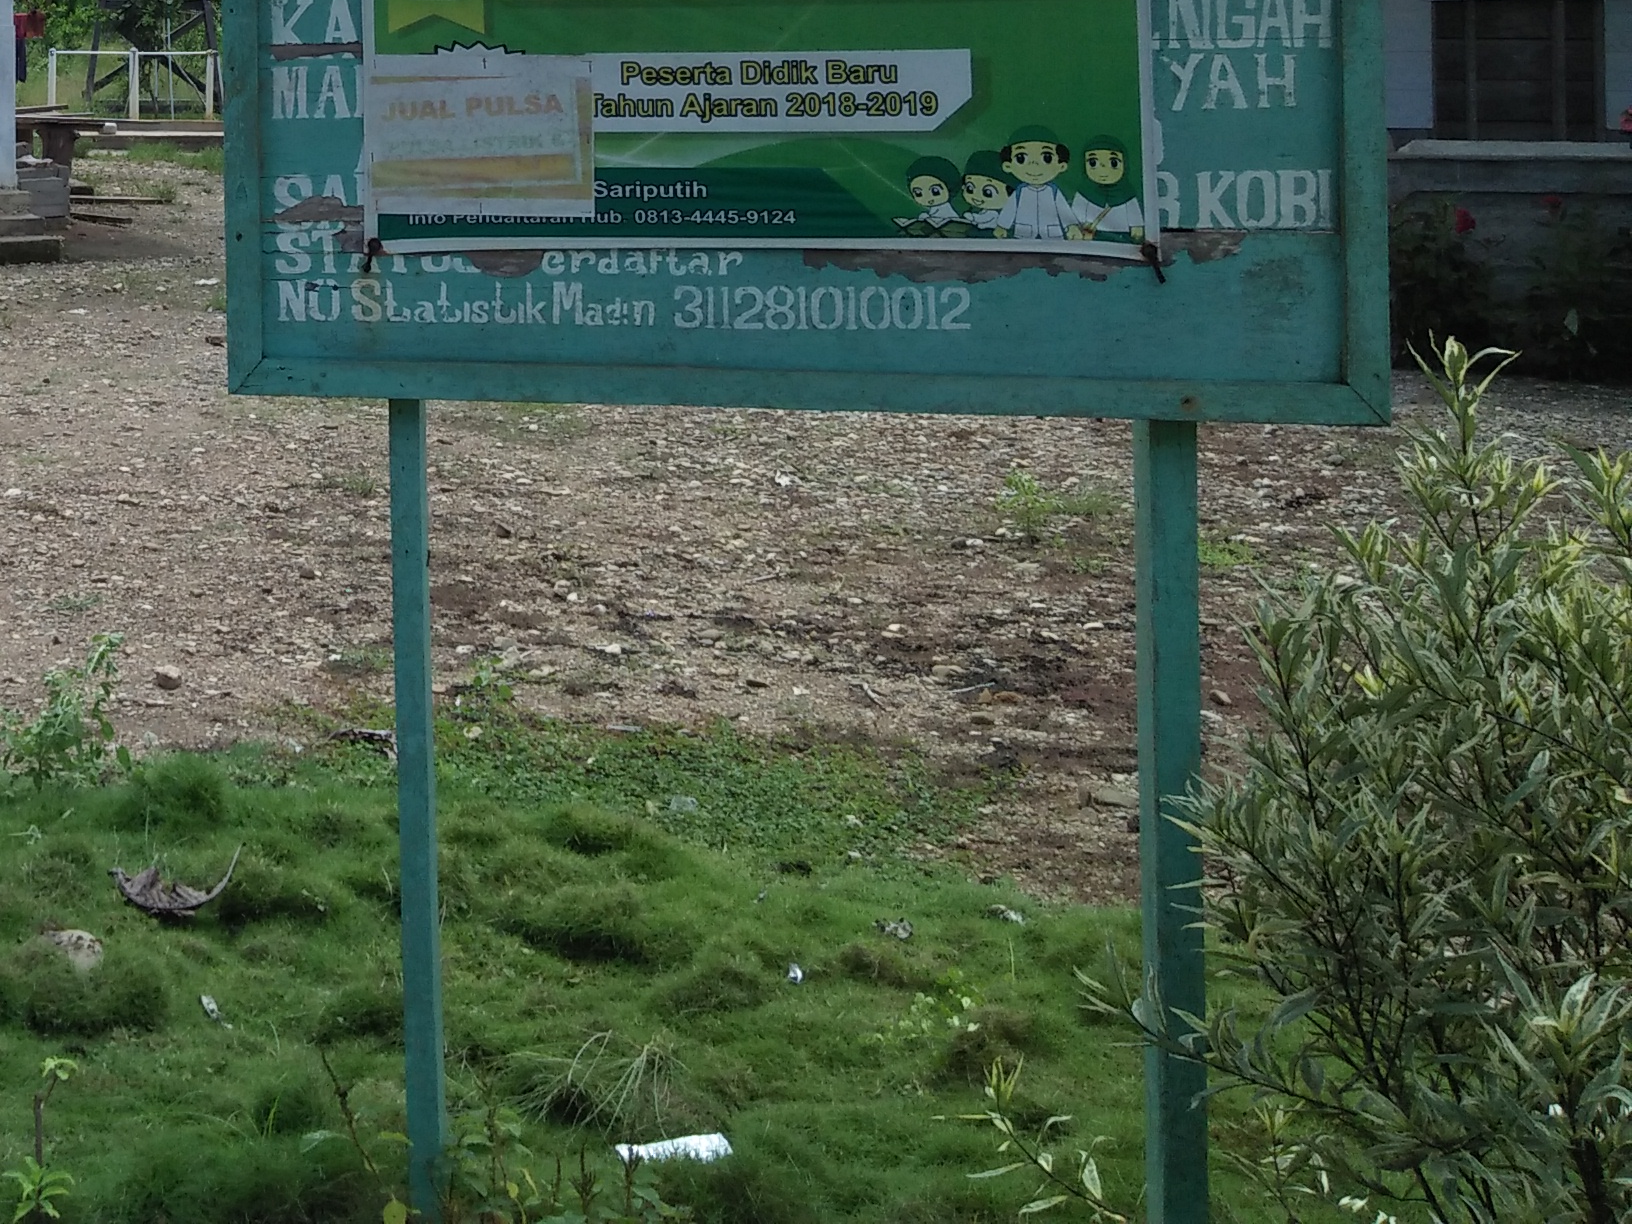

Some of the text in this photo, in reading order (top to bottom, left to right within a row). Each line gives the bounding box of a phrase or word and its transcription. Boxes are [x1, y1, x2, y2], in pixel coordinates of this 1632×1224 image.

[620, 59, 898, 86] Peserta Didik Baru
[381, 93, 565, 122] JUAL PULSA
[679, 93, 779, 123] Ajaran
[784, 91, 939, 117] 2018-2019
[594, 180, 709, 202] Sariputih
[1195, 169, 1333, 228] KOBI
[633, 210, 798, 224] 0813-4445-9124
[674, 285, 972, 330] 311281010012
